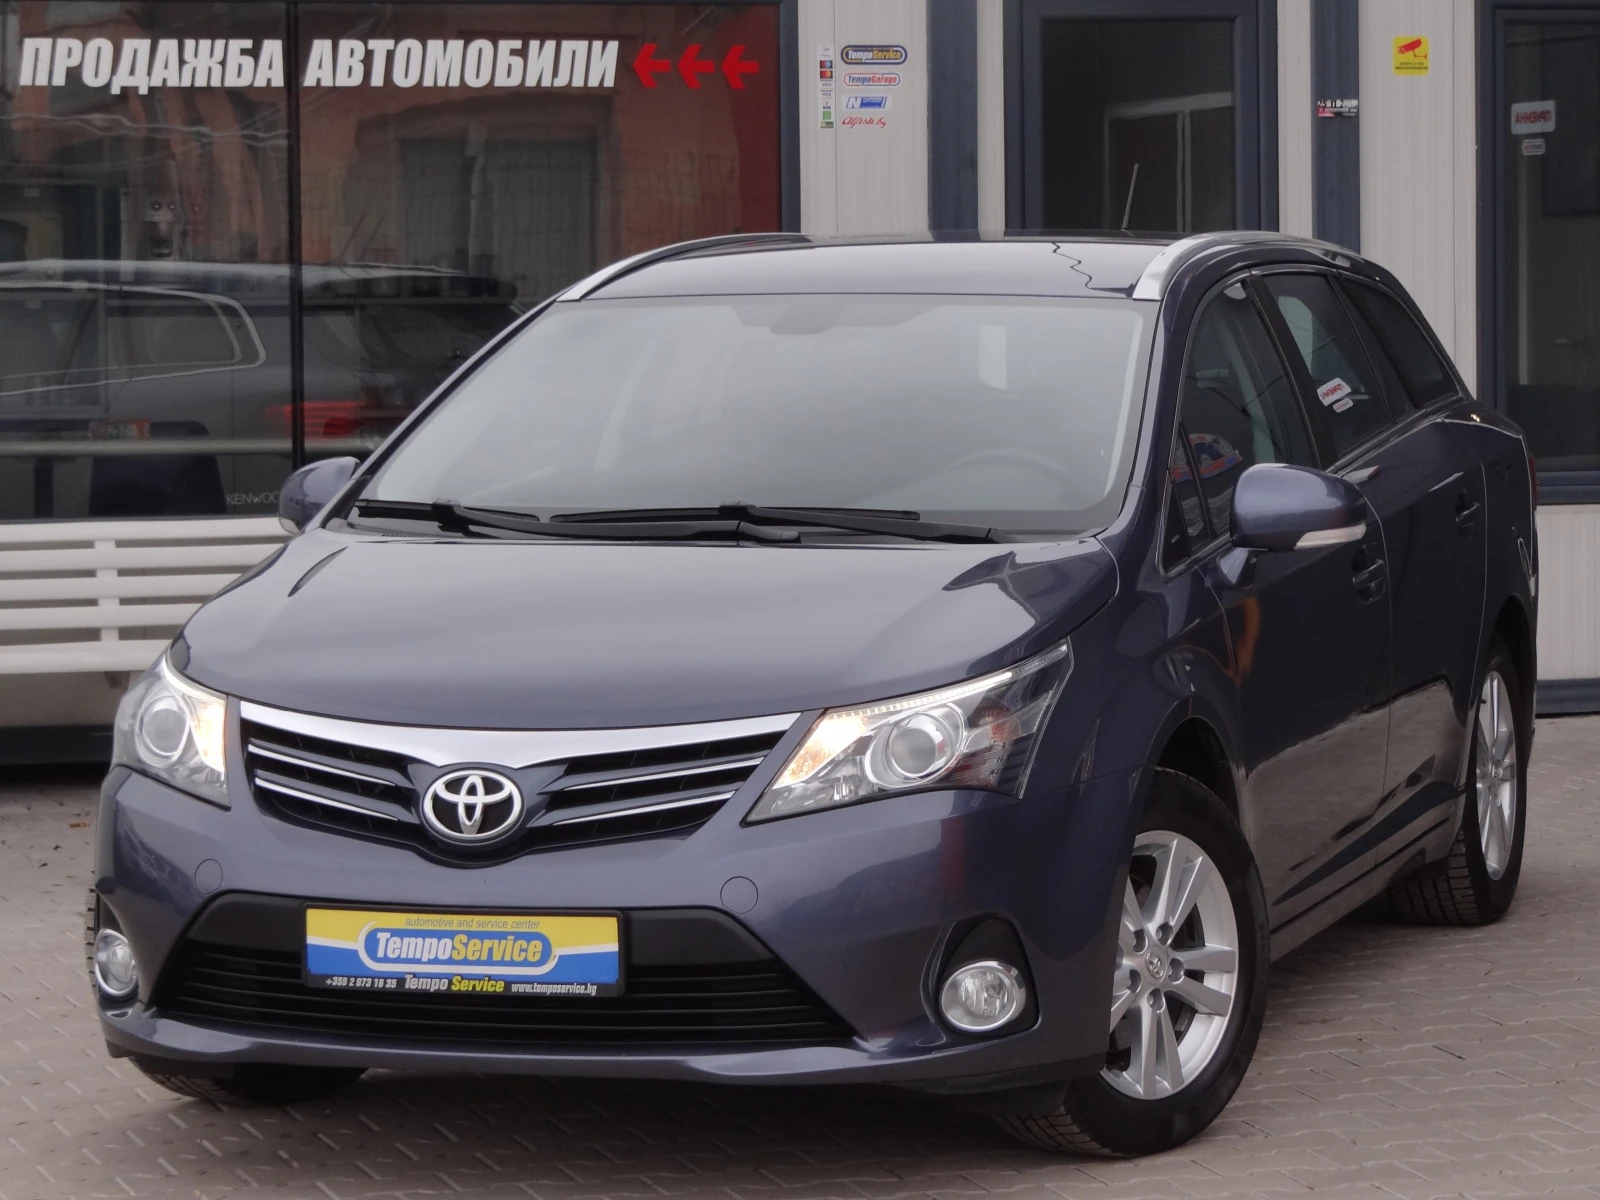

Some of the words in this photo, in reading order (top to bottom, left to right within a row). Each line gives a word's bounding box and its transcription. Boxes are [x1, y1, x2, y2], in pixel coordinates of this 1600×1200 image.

[19, 37, 285, 95] ПРОДАЖБА
[303, 38, 619, 88] АВТОМОБИЛИ
[226, 491, 280, 505] KENWOO
[405, 917, 454, 927] automotive
[456, 918, 474, 928] and
[476, 918, 508, 929] service
[511, 920, 540, 929] center
[376, 932, 543, 963] TempoService
[349, 977, 355, 987] 2
[374, 978, 384, 988] 16
[385, 978, 397, 989] 35
[404, 974, 449, 992] Tempo
[451, 975, 505, 993] Service
[511, 982, 597, 996] www.temposervice.bg
